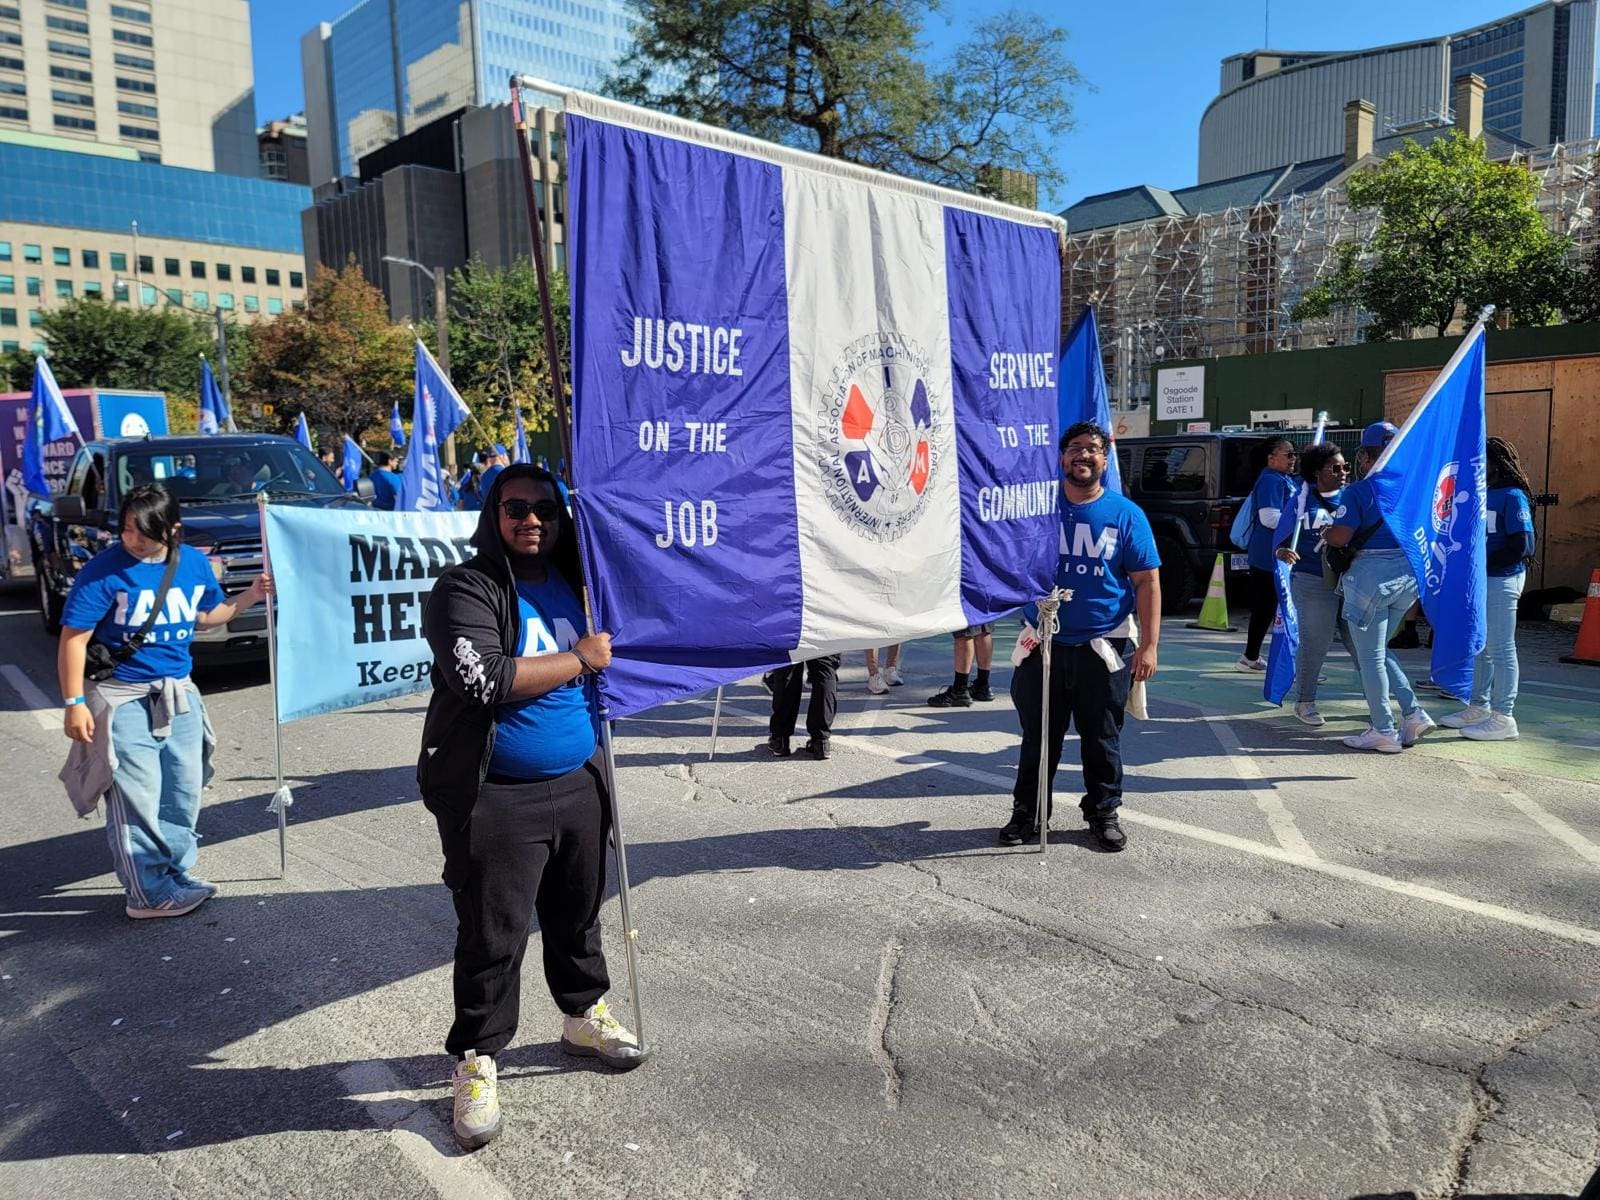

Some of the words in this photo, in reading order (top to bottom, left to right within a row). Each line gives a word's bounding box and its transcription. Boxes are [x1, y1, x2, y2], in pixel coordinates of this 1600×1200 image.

[620, 316, 743, 376] JUSTICE
[989, 352, 1055, 389] SERVICE
[1163, 385, 1198, 396] Osgoode
[1166, 396, 1194, 404] Station
[1166, 405, 1188, 415] GATE
[1190, 405, 1193, 413] 1
[639, 420, 670, 452] ON
[685, 422, 727, 453] THE
[997, 426, 1018, 449] TO
[1025, 424, 1050, 446] THE
[856, 459, 871, 484] A
[914, 451, 927, 475] M
[978, 479, 1060, 522] COMMUNIT
[656, 499, 719, 549] JOB
[114, 584, 207, 627] IAM
[356, 660, 432, 687] Keep
